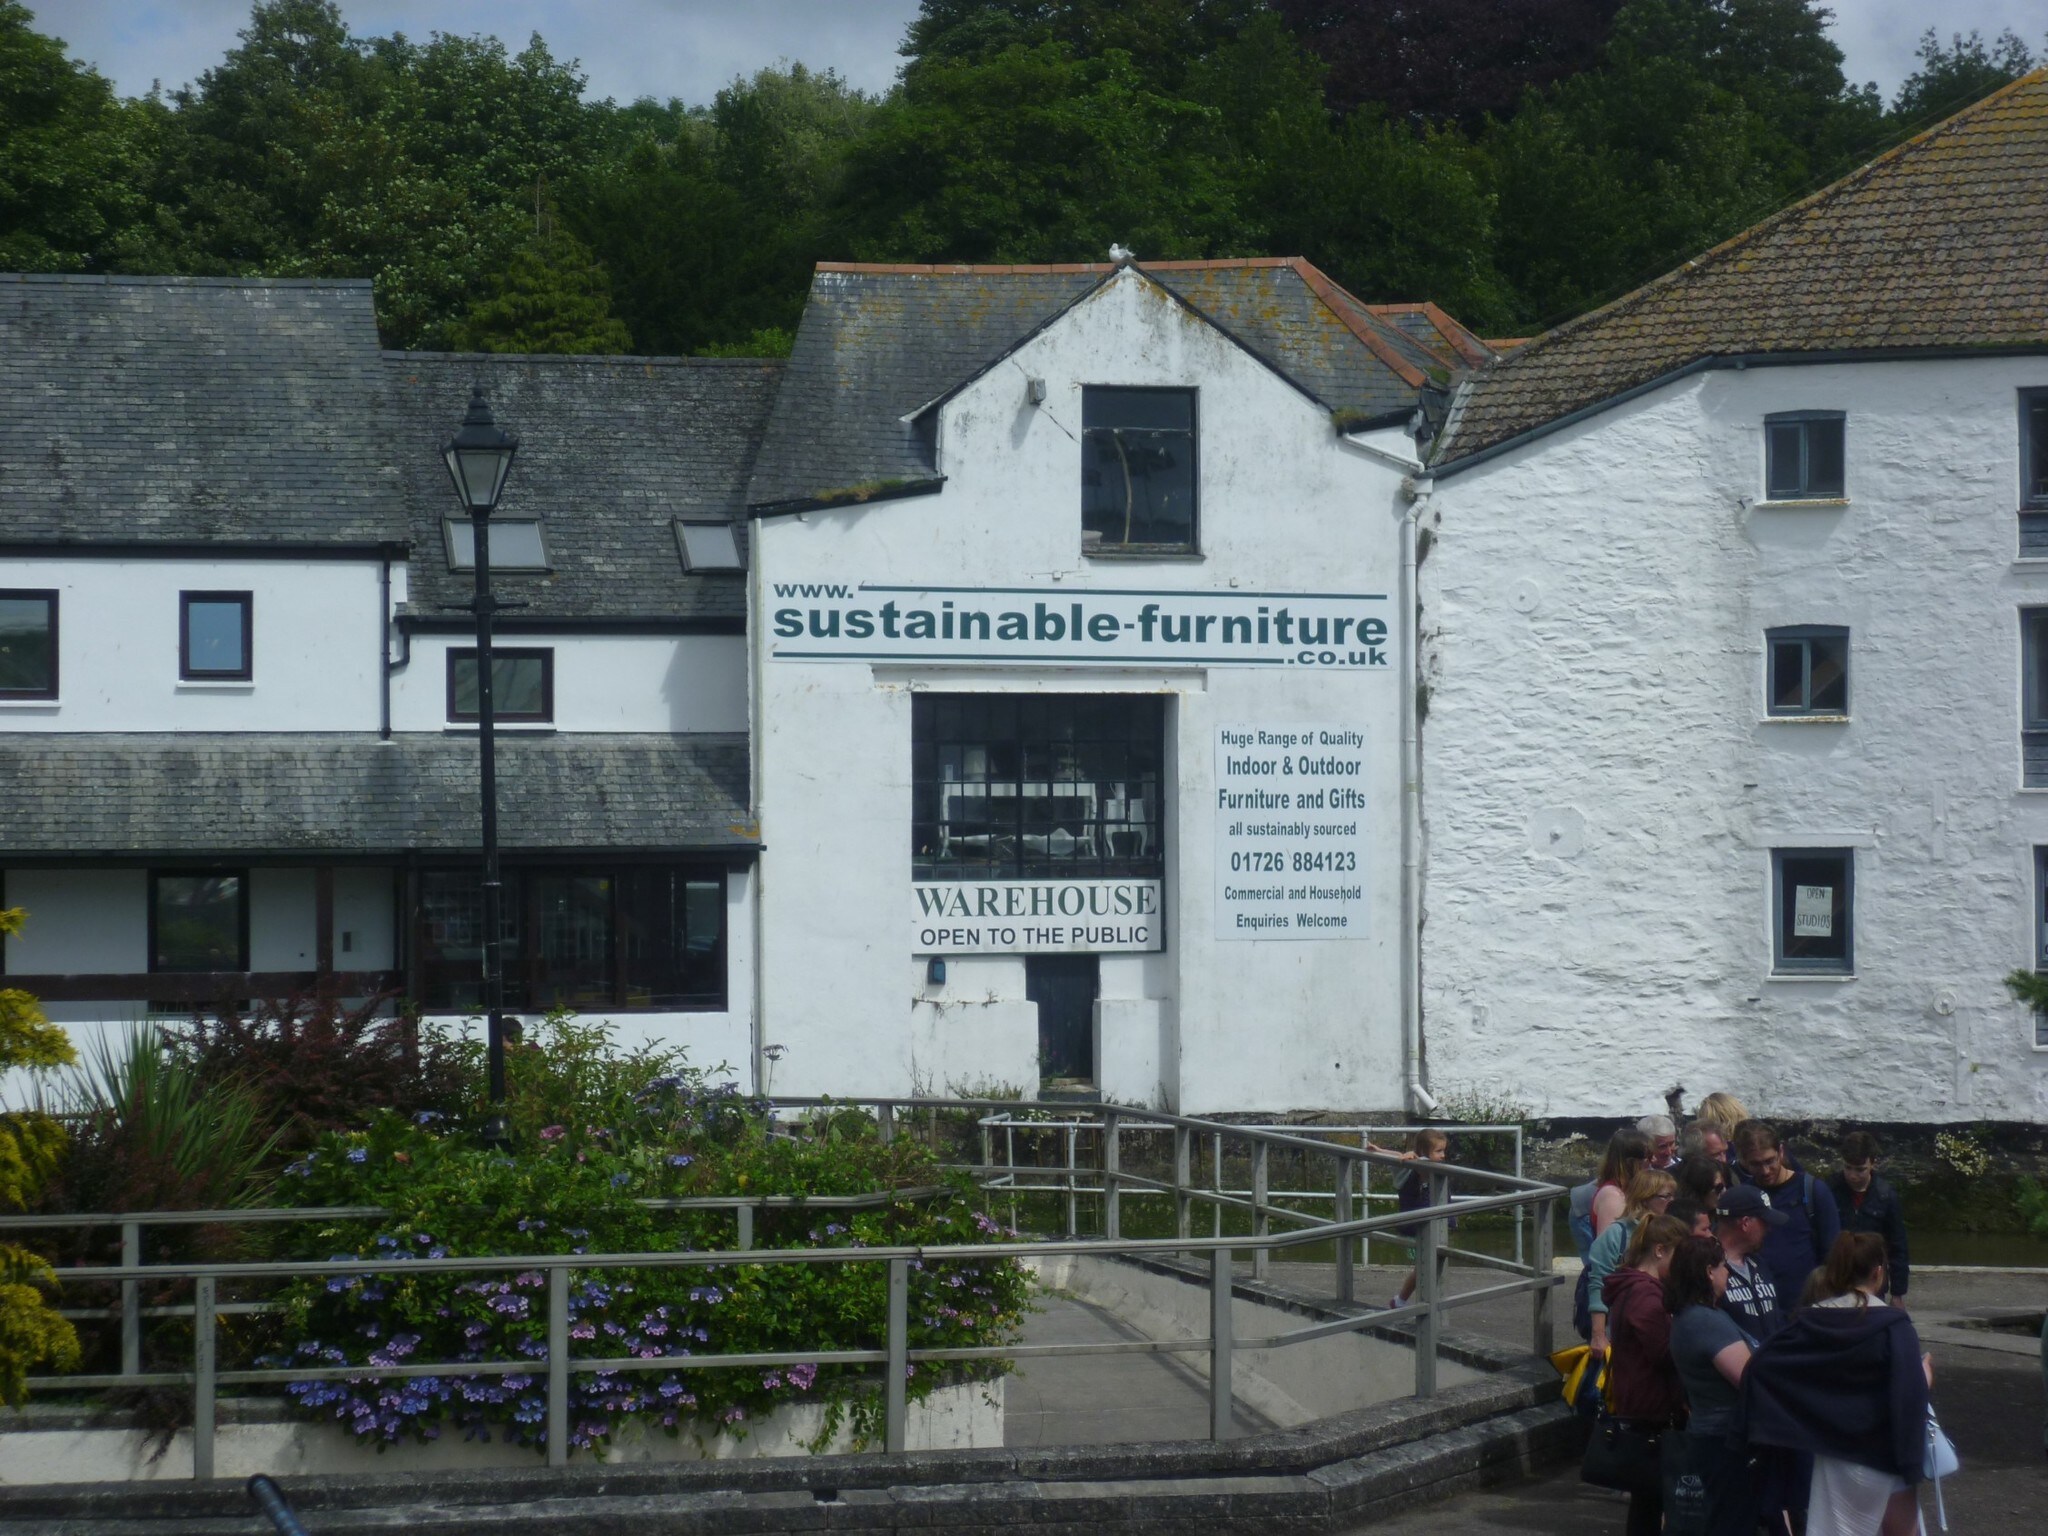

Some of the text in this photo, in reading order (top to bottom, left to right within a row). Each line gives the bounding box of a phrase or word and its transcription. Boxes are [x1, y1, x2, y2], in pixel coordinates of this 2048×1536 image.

[773, 583, 854, 599] www.
[773, 601, 1388, 646] sustainable-furniture
[1287, 647, 1388, 666] .co.uk
[1221, 730, 1364, 749] Huge Range of Quality
[1227, 755, 1362, 776] Indoor & Outdoor
[1218, 787, 1366, 810] Furniture and Gifts
[1228, 821, 1357, 840] all sustainably sourced
[1230, 851, 1356, 872] 01726 884123
[914, 885, 1157, 917] WAREHOUSE
[1224, 885, 1361, 900] Commercial and Household
[1806, 887, 1826, 899] OPEN
[1236, 913, 1348, 931] Enquiries Welcome
[1796, 914, 1831, 929] STUDIOS
[920, 926, 1149, 946] OPEN TO THE PUBLIC
